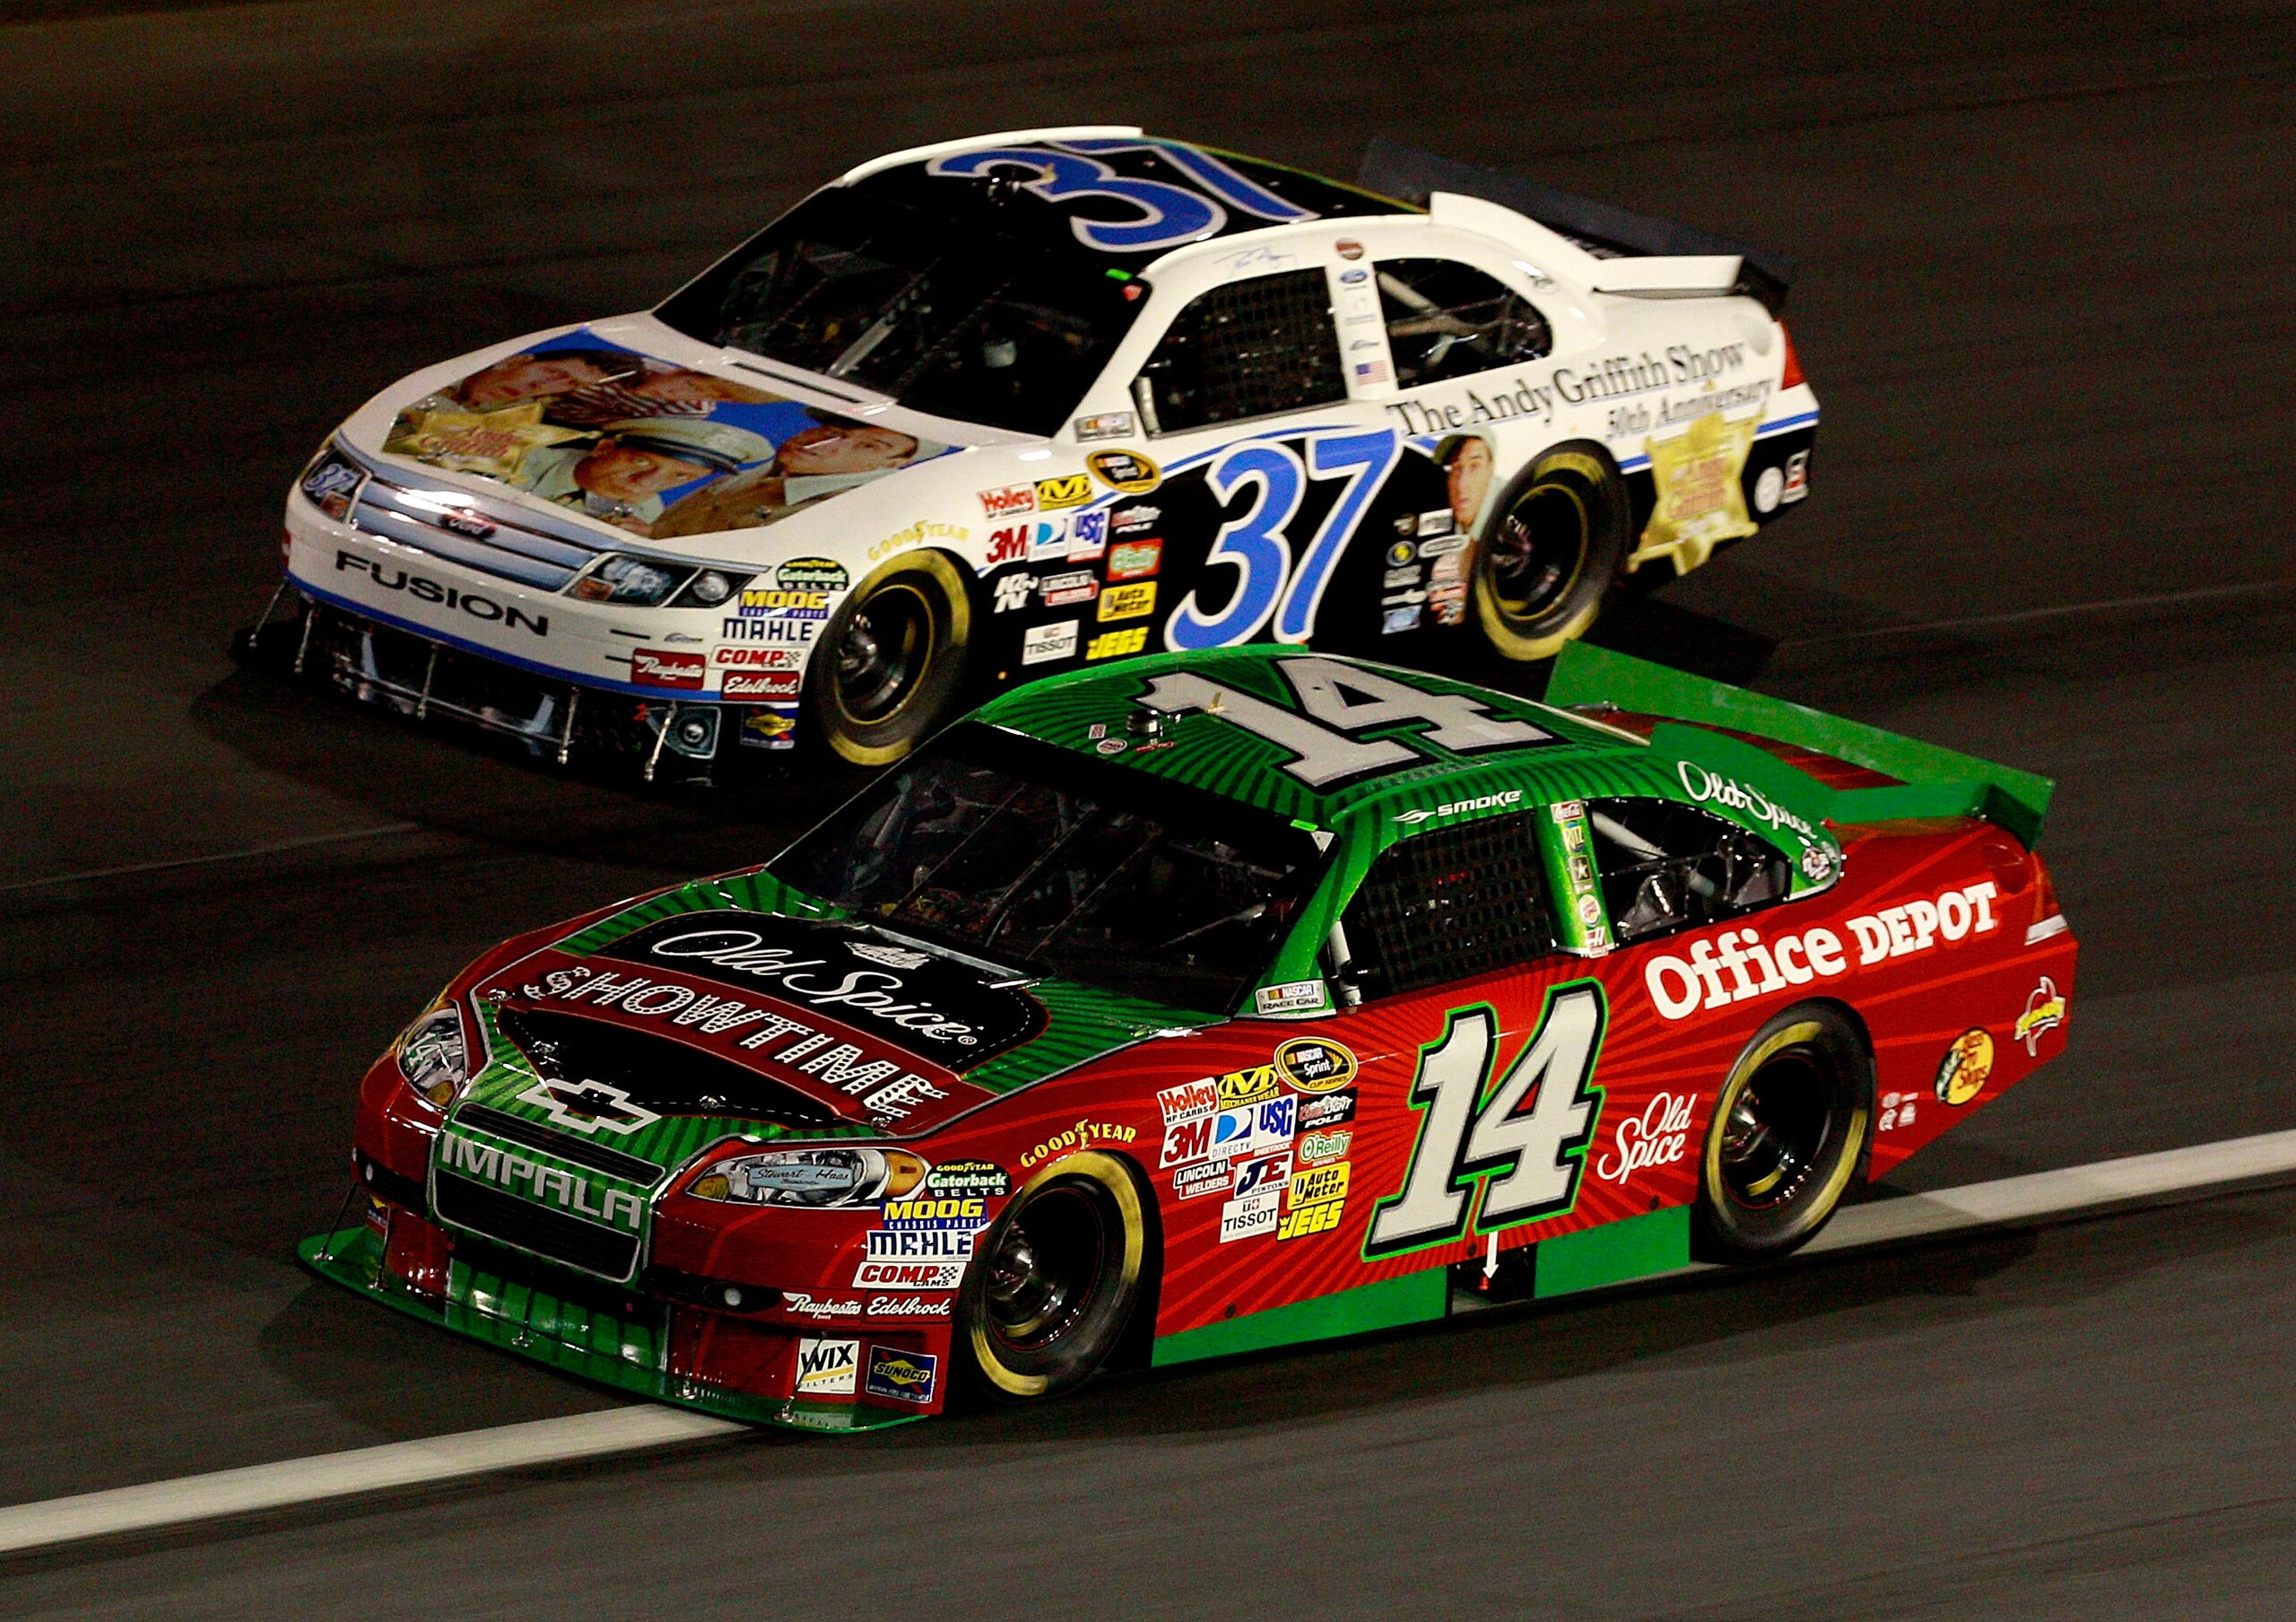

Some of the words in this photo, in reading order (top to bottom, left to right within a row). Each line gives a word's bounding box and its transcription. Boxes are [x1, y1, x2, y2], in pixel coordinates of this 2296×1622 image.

[1387, 401, 1461, 437] The
[1466, 379, 1554, 424] Andy
[1553, 351, 1671, 406] Griffith
[1666, 342, 1747, 383] Show
[304, 463, 355, 494] 37
[987, 524, 1029, 563] 3M
[1163, 426, 1405, 651] 37
[335, 550, 550, 638] FUSION
[740, 590, 827, 610] MOOG
[722, 618, 813, 641] MAHLE
[717, 649, 785, 665] COMP
[1134, 657, 1557, 787] 14
[651, 929, 826, 978] Old
[1644, 927, 1847, 1021] Office
[1848, 881, 1998, 966] DEPOT
[1263, 998, 1295, 1010] RACE
[1296, 997, 1320, 1006] CAR
[524, 966, 952, 1119] SHOWTIME
[1304, 1060, 1331, 1078] Sprint
[1159, 1085, 1217, 1115] Holley
[1179, 1105, 1209, 1120] CARBS
[1259, 1097, 1293, 1138] USG
[1305, 1113, 1344, 1129] POLE
[1369, 986, 1601, 1248] 14
[1642, 1091, 1698, 1141] Old
[1164, 1116, 1213, 1164] 3M
[1213, 1140, 1251, 1158] DIRECTV
[1302, 1134, 1349, 1160] O'Reilly
[1597, 1116, 1686, 1184] Spice
[442, 1132, 642, 1229] IMPALA
[815, 1169, 848, 1181] Haas
[926, 1173, 1006, 1188] Gatorback
[1177, 1160, 1226, 1185] LINCOLN
[1236, 1153, 1291, 1196] JE
[1308, 1169, 1339, 1187] Auto
[935, 1187, 1005, 1197] BELTS
[1186, 1175, 1230, 1195] WELDERS
[1251, 1181, 1290, 1194] PISTONS
[1305, 1182, 1344, 1199] Meter
[883, 1199, 985, 1221] MOOG
[1223, 1208, 1277, 1232] TISSOT
[1277, 1199, 1345, 1241] JEGS
[889, 1219, 938, 1230] CHASSIS
[945, 1218, 984, 1228] PARTS
[868, 1232, 973, 1256] MAHLE
[860, 1265, 942, 1285] COMP
[913, 1279, 950, 1287] CAMS
[783, 1292, 862, 1319] Raybestos
[867, 1296, 952, 1316] Edelbrock
[800, 1343, 857, 1374] WIX
[875, 1363, 930, 1382] SUNOCO
